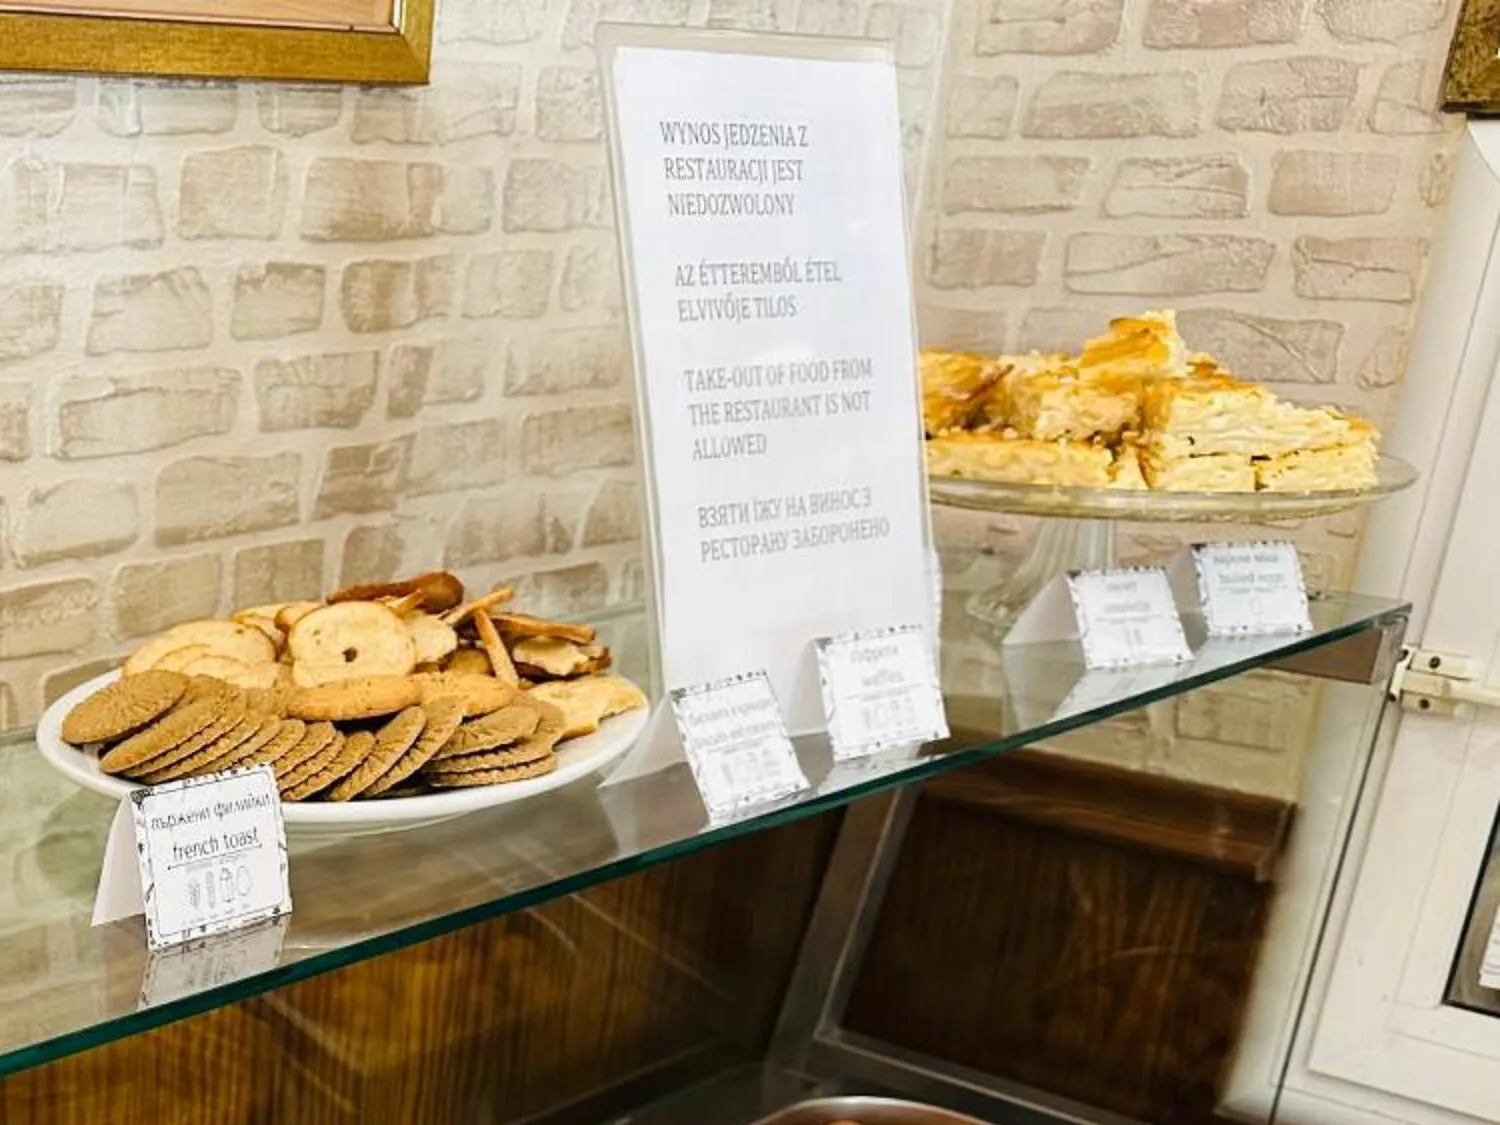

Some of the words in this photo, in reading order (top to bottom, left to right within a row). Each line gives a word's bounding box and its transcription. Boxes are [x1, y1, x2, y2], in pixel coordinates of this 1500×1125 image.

[660, 121, 722, 145] WYNOS
[723, 123, 797, 149] JEDZENIA
[799, 126, 809, 147] Z
[664, 158, 768, 184] RESTAURACJI
[771, 160, 804, 184] JEST
[667, 193, 795, 216] NIEDOZWOLONY
[675, 265, 695, 286] AZ
[805, 258, 842, 283] ÉTEL
[752, 295, 797, 318] TILOS
[684, 365, 763, 393] TAKE-OUT
[766, 364, 785, 387] OF
[789, 361, 829, 384] FOOD
[832, 358, 873, 381] FROM
[689, 402, 721, 426] THE
[723, 394, 821, 424] RESTAURANT
[825, 394, 838, 416] IS
[841, 390, 871, 413] NOT
[693, 433, 767, 460] ALLOWED
[698, 503, 750, 529] ВЗЯТИ
[786, 496, 807, 518] НА
[809, 489, 860, 515] ВИНОС
[700, 531, 790, 563] РЕСТОРАНУ
[792, 516, 891, 550] ЗАБОРОНЕНО
[223, 827, 258, 849] toast
